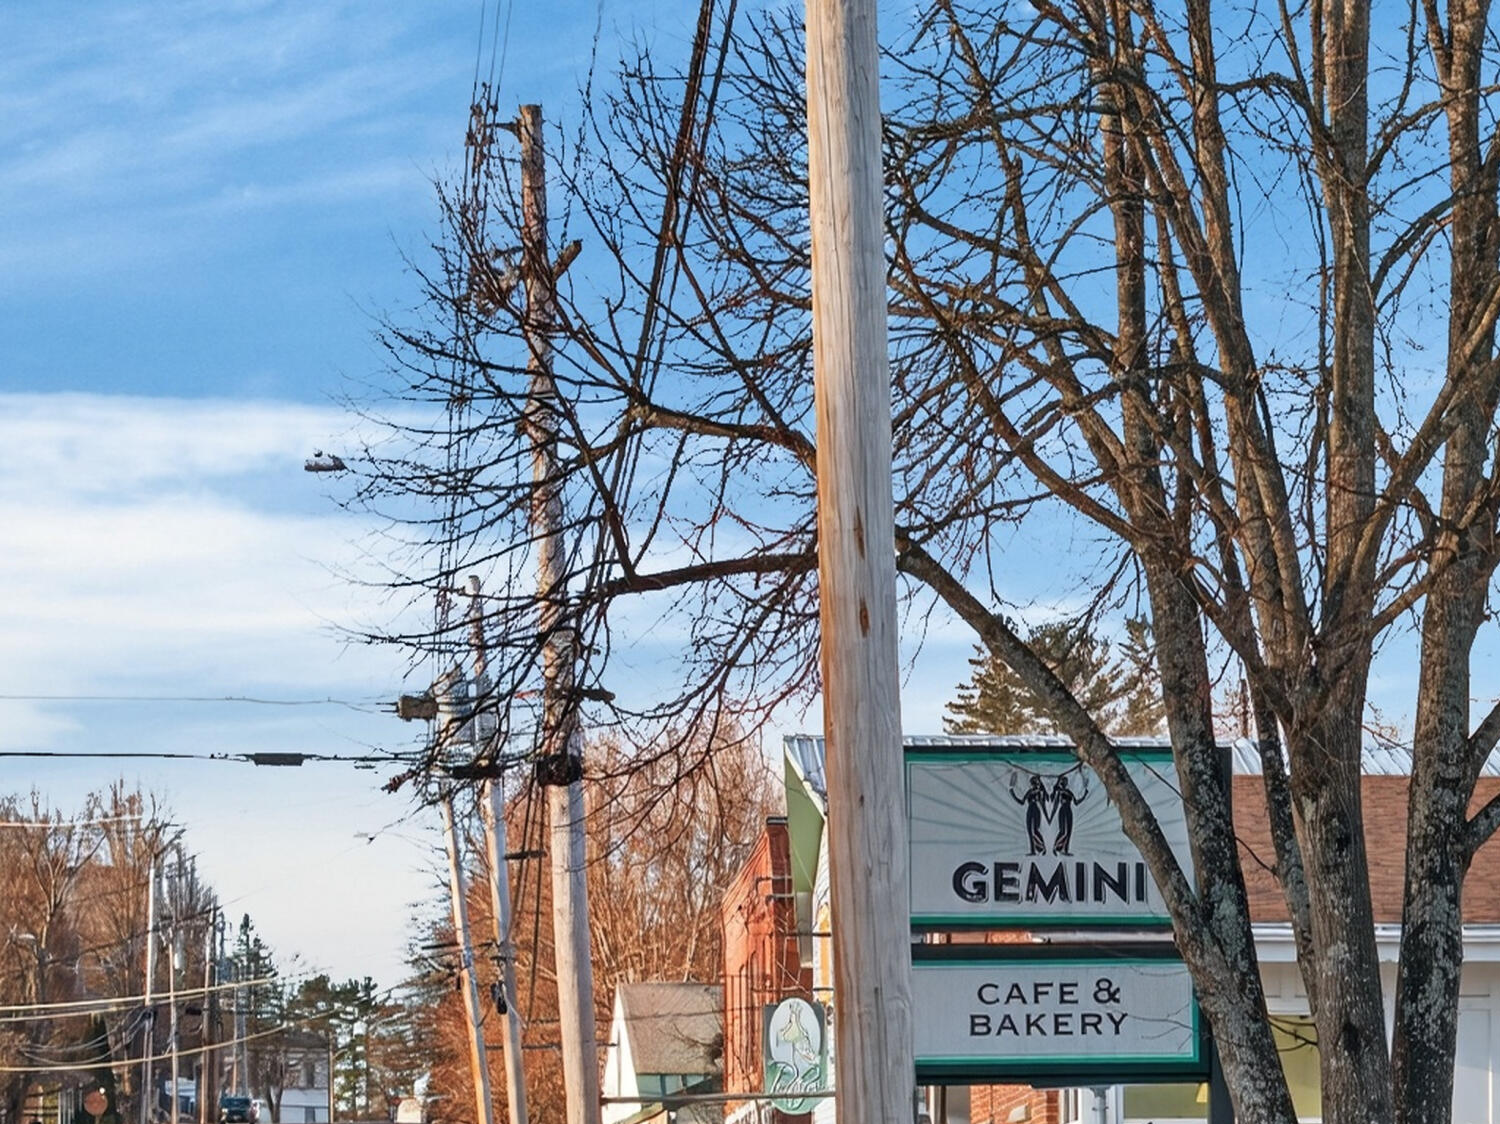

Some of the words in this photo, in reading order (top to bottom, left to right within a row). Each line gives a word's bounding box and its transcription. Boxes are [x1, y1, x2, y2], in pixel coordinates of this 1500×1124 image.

[952, 861, 1149, 904] GEMINI
[977, 982, 1080, 1005] CAFE
[1092, 977, 1122, 1004] &
[969, 1012, 1129, 1037] BAKERY
